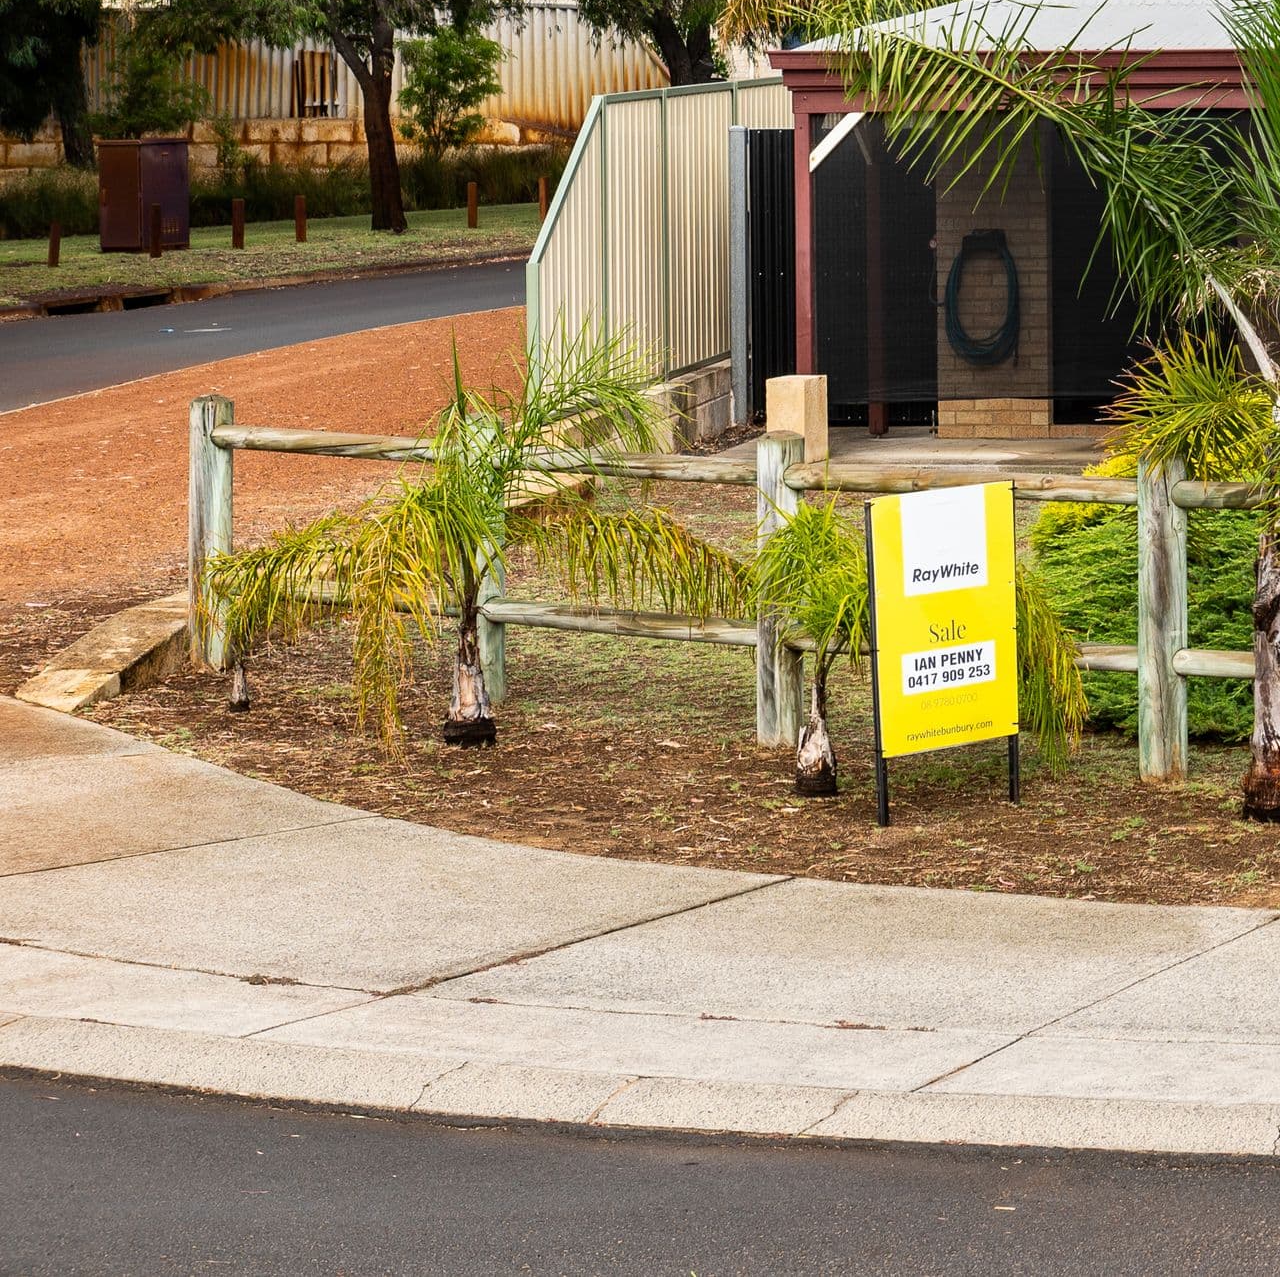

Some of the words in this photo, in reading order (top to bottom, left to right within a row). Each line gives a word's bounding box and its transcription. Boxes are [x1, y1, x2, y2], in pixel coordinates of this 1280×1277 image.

[929, 619, 967, 643] Sale
[915, 655, 936, 672] IAN
[941, 648, 983, 667] PENNY
[908, 672, 938, 689] 0417
[942, 668, 965, 683] 909
[968, 663, 991, 679] 253
[907, 719, 993, 742] raywhitebunbury.com
